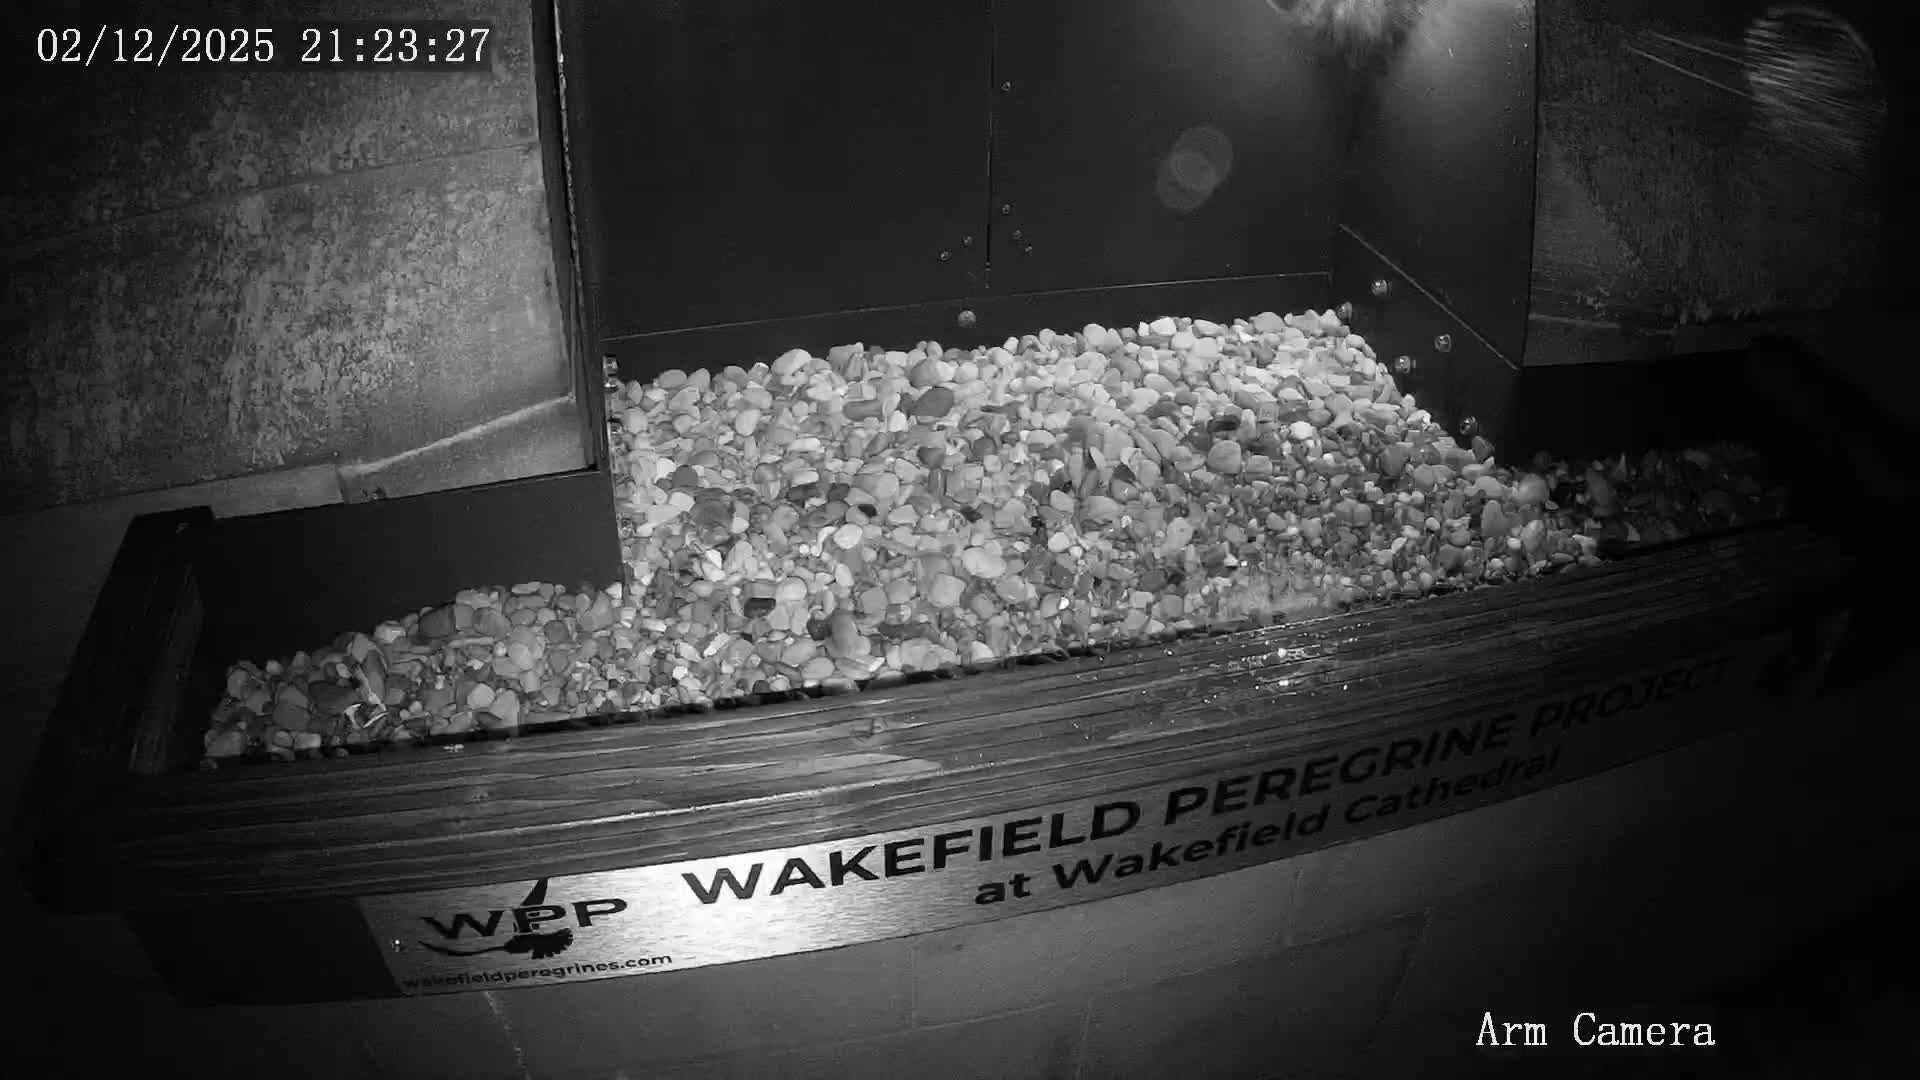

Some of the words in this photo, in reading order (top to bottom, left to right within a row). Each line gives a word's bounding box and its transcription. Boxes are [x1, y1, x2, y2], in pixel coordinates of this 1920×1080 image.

[682, 801, 1141, 904] WAKEFIELD
[1164, 713, 1517, 825] PEREGRINE
[1531, 656, 1735, 736] PROJECT
[975, 872, 1031, 905] at
[1053, 805, 1330, 888] Wakefield
[1344, 744, 1563, 824] Cathedral
[420, 898, 627, 939] WPP
[402, 953, 672, 989] wakefieldperegrines.com
